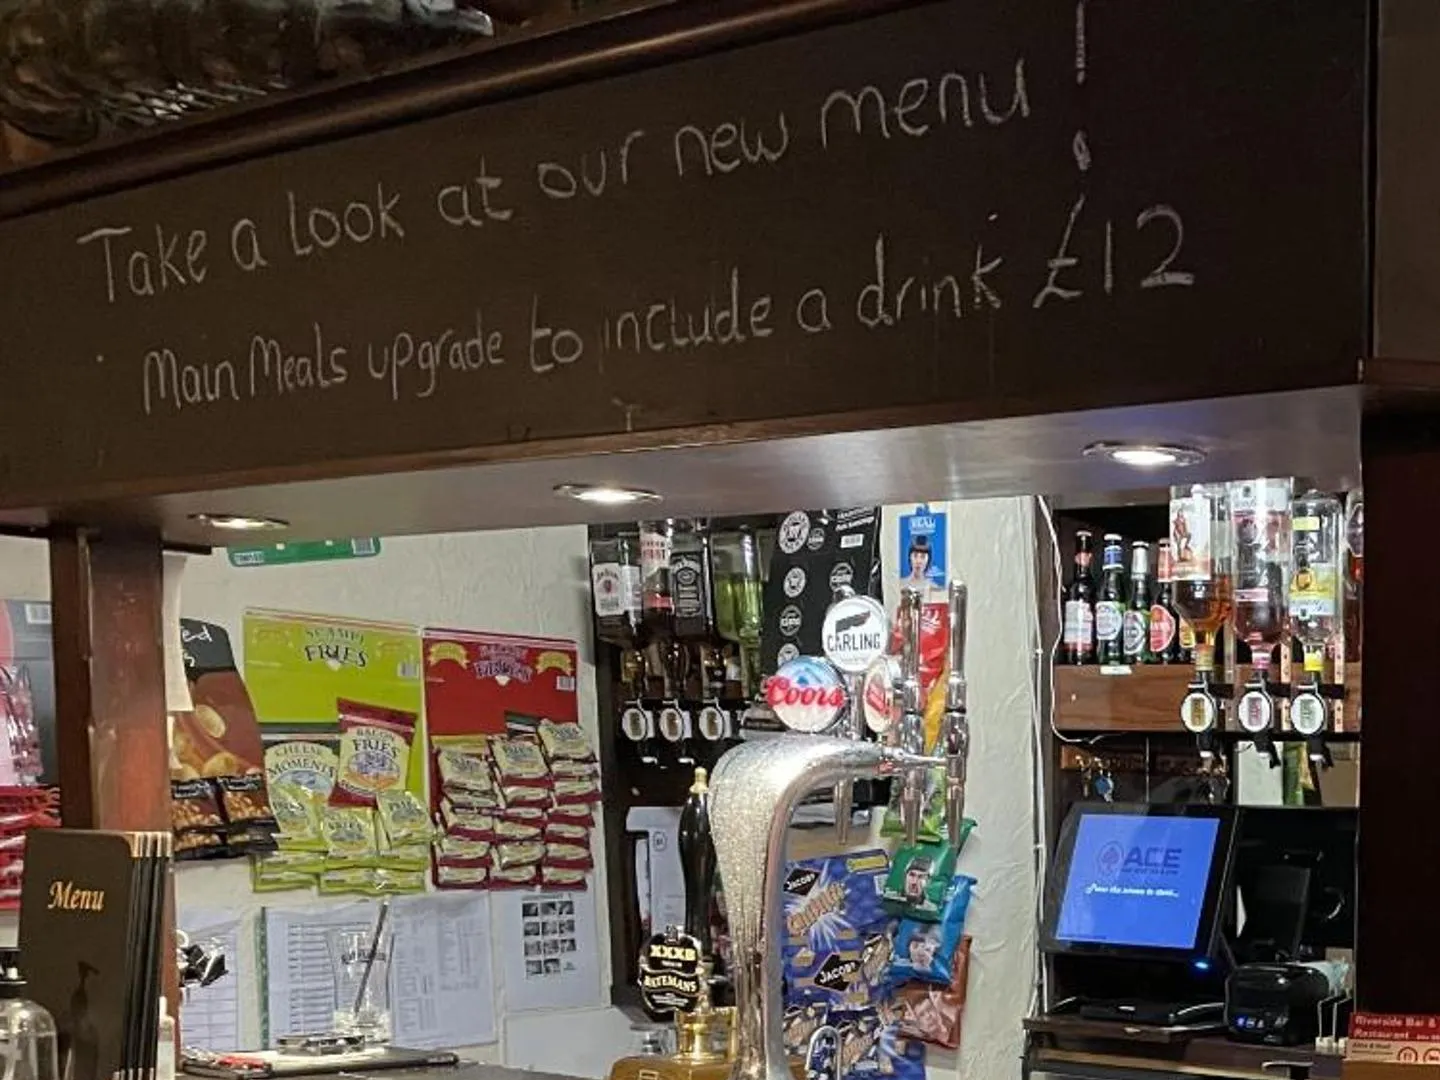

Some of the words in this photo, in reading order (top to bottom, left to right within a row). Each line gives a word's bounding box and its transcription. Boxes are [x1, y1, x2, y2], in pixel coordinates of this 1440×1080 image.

[77, 226, 207, 301] Take
[230, 219, 267, 271] a
[437, 156, 514, 227] at
[537, 129, 644, 201] our
[675, 112, 789, 176] new
[142, 347, 240, 414] Main
[250, 322, 347, 397] Meals
[367, 311, 504, 400] upgrade
[530, 297, 583, 374] to
[798, 288, 831, 333] a
[856, 233, 1003, 328] drink
[1033, 193, 1195, 308] £12
[826, 632, 881, 652] CARLING
[304, 644, 368, 668] FRIES
[764, 675, 845, 709] Coors
[352, 738, 399, 759] FRIES
[268, 758, 335, 778] MOMENTS
[1124, 846, 1183, 869] ACE
[48, 881, 105, 912] Menu
[650, 945, 696, 961] XXXB
[644, 975, 697, 992] BATEMANS
